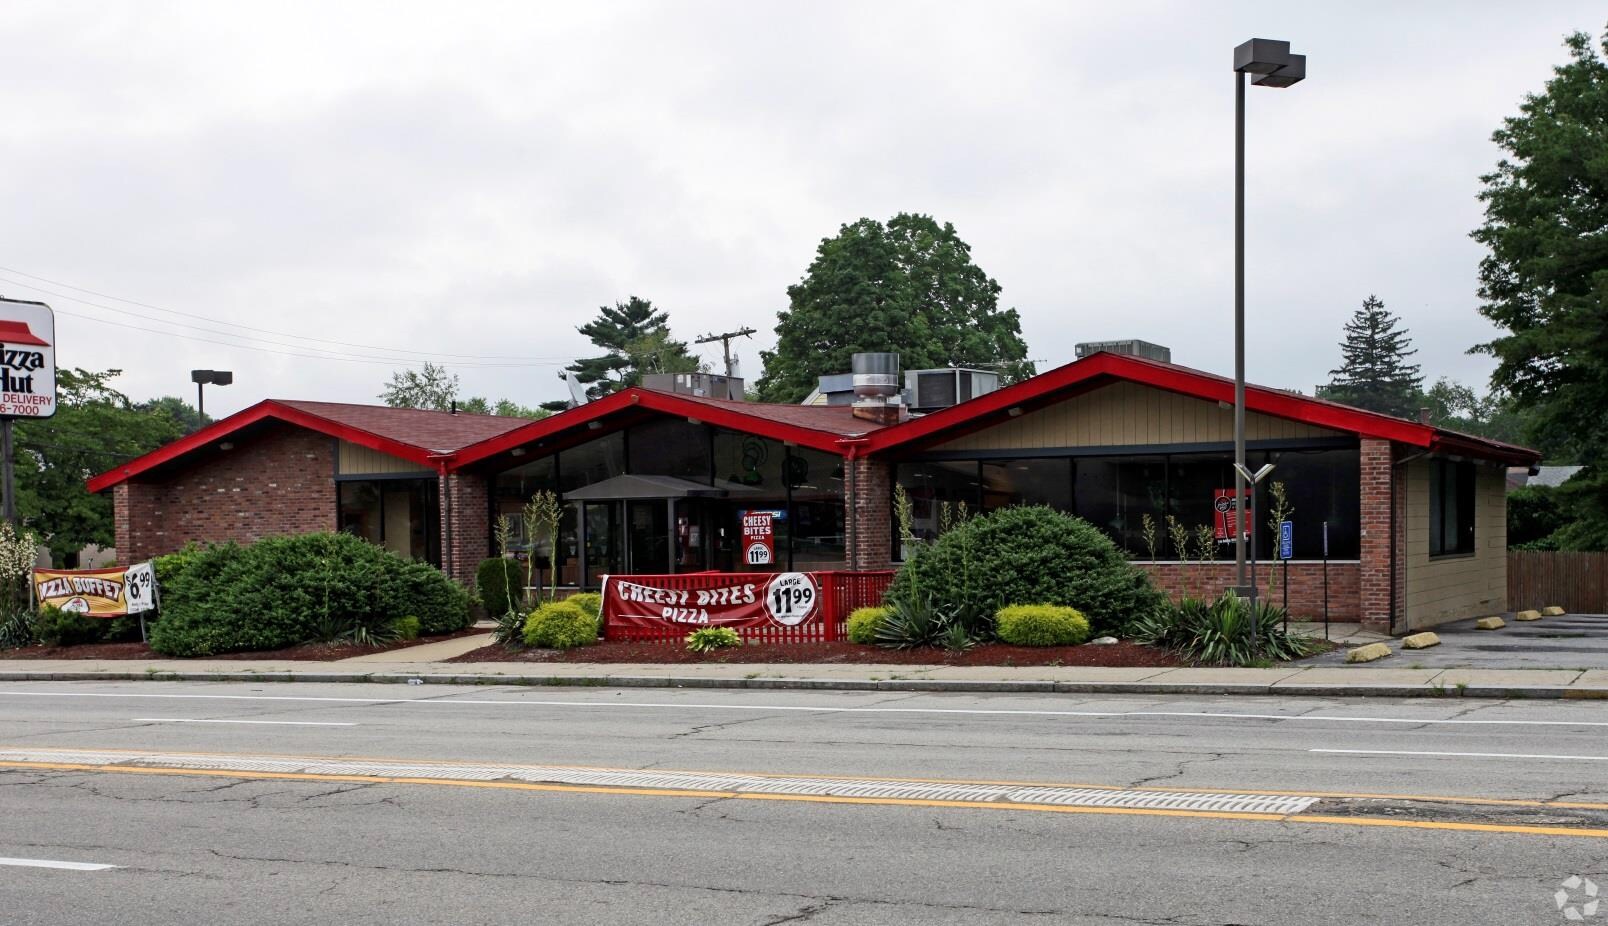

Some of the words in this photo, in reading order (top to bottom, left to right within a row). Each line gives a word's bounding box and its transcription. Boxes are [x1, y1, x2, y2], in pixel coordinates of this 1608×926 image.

[3, 393, 52, 406] DELIVERY
[743, 516, 771, 527] CHEESY
[743, 527, 771, 535] BITES
[73, 576, 122, 600] BUFFET
[780, 578, 801, 587] LARGE
[662, 607, 709, 623] PIZZA
